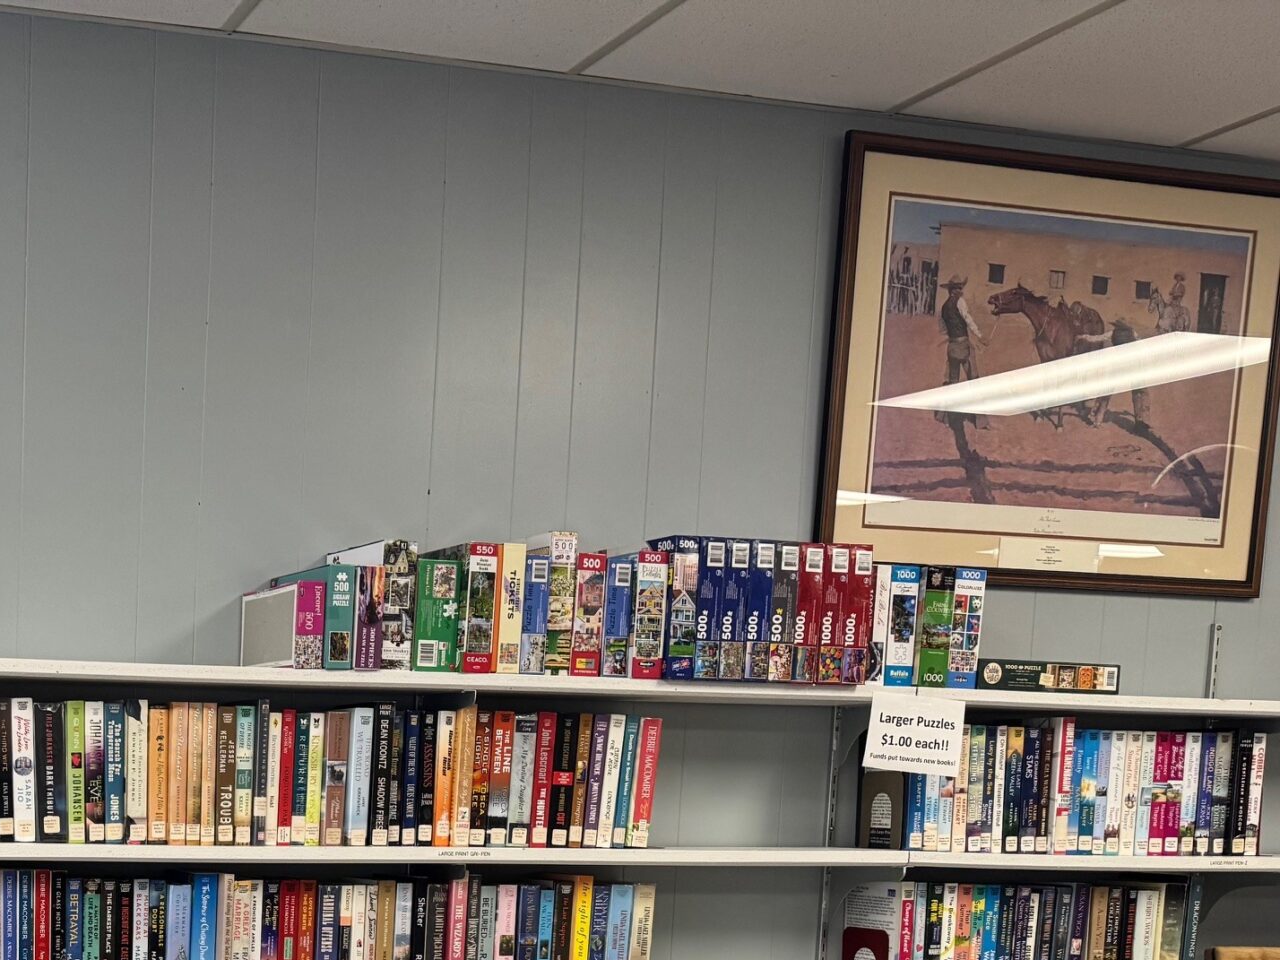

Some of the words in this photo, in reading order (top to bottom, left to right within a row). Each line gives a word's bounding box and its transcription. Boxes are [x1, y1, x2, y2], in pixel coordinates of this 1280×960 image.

[476, 545, 493, 555] 550
[645, 554, 661, 562] 500
[583, 559, 601, 569] 500
[897, 571, 916, 579] 1000
[963, 571, 980, 579] 1000
[334, 582, 349, 591] 500
[506, 570, 517, 619] TICKETS
[305, 612, 313, 629] 500
[880, 712, 914, 727] Larger
[917, 716, 955, 730] Puzzles
[494, 728, 504, 774] BETWEEN
[881, 734, 912, 748] $1.00
[915, 738, 949, 751] each!!
[503, 746, 511, 773] LINE
[870, 752, 885, 760] Funds
[887, 754, 898, 762] put
[899, 755, 923, 763] towards
[936, 758, 956, 767] books!
[1025, 755, 1034, 779] STARS
[72, 773, 82, 822] JOHANSEN
[69, 894, 78, 947] BETRAYAL
[417, 897, 426, 927] Shelter
[1188, 901, 1200, 958] DRAGONWINGS
